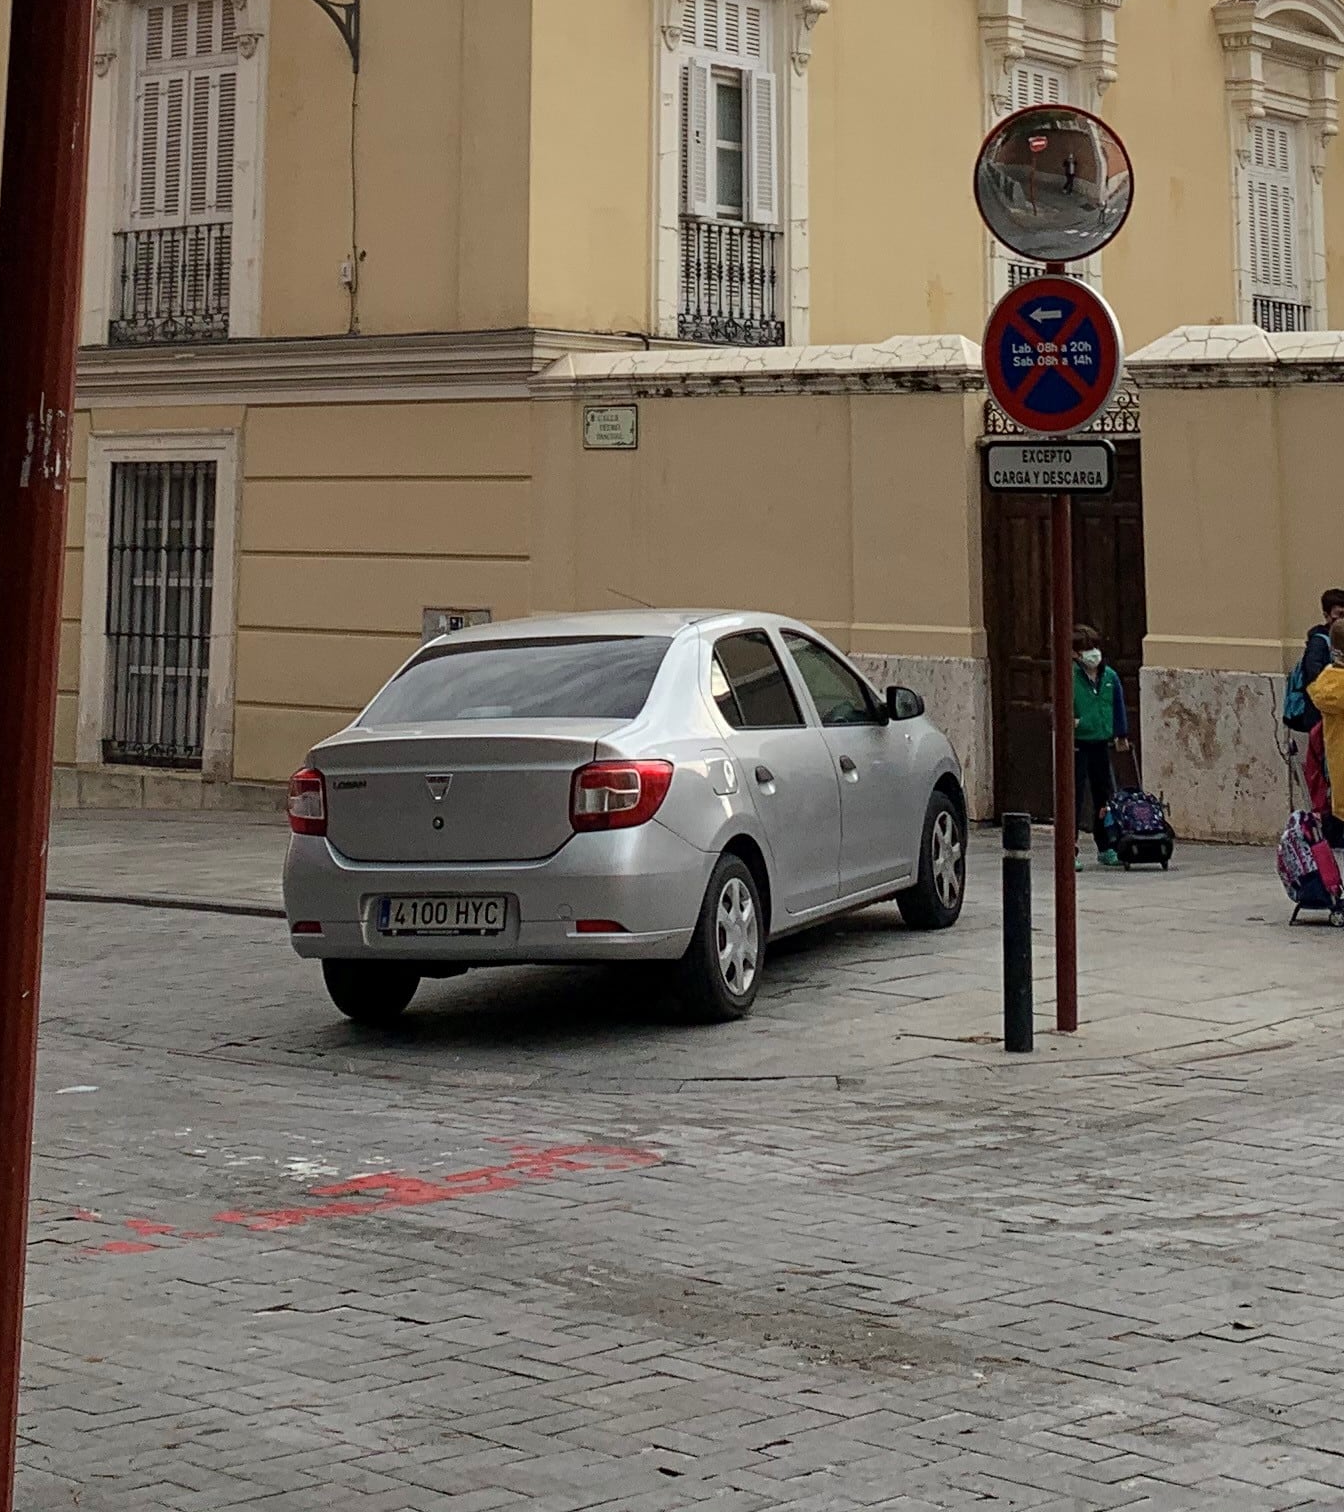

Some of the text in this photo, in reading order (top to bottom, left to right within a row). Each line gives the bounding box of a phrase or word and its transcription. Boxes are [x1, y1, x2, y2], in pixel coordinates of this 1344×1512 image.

[1012, 341, 1092, 354] Lab. 08h a 20h
[1037, 355, 1058, 366] 08h
[1062, 356, 1068, 365] a
[1073, 355, 1093, 366] 14h
[1022, 449, 1072, 464] EXCEPTO
[993, 470, 1103, 485] CARGA Y DESCARGA
[394, 900, 498, 926] 4100 HYC
